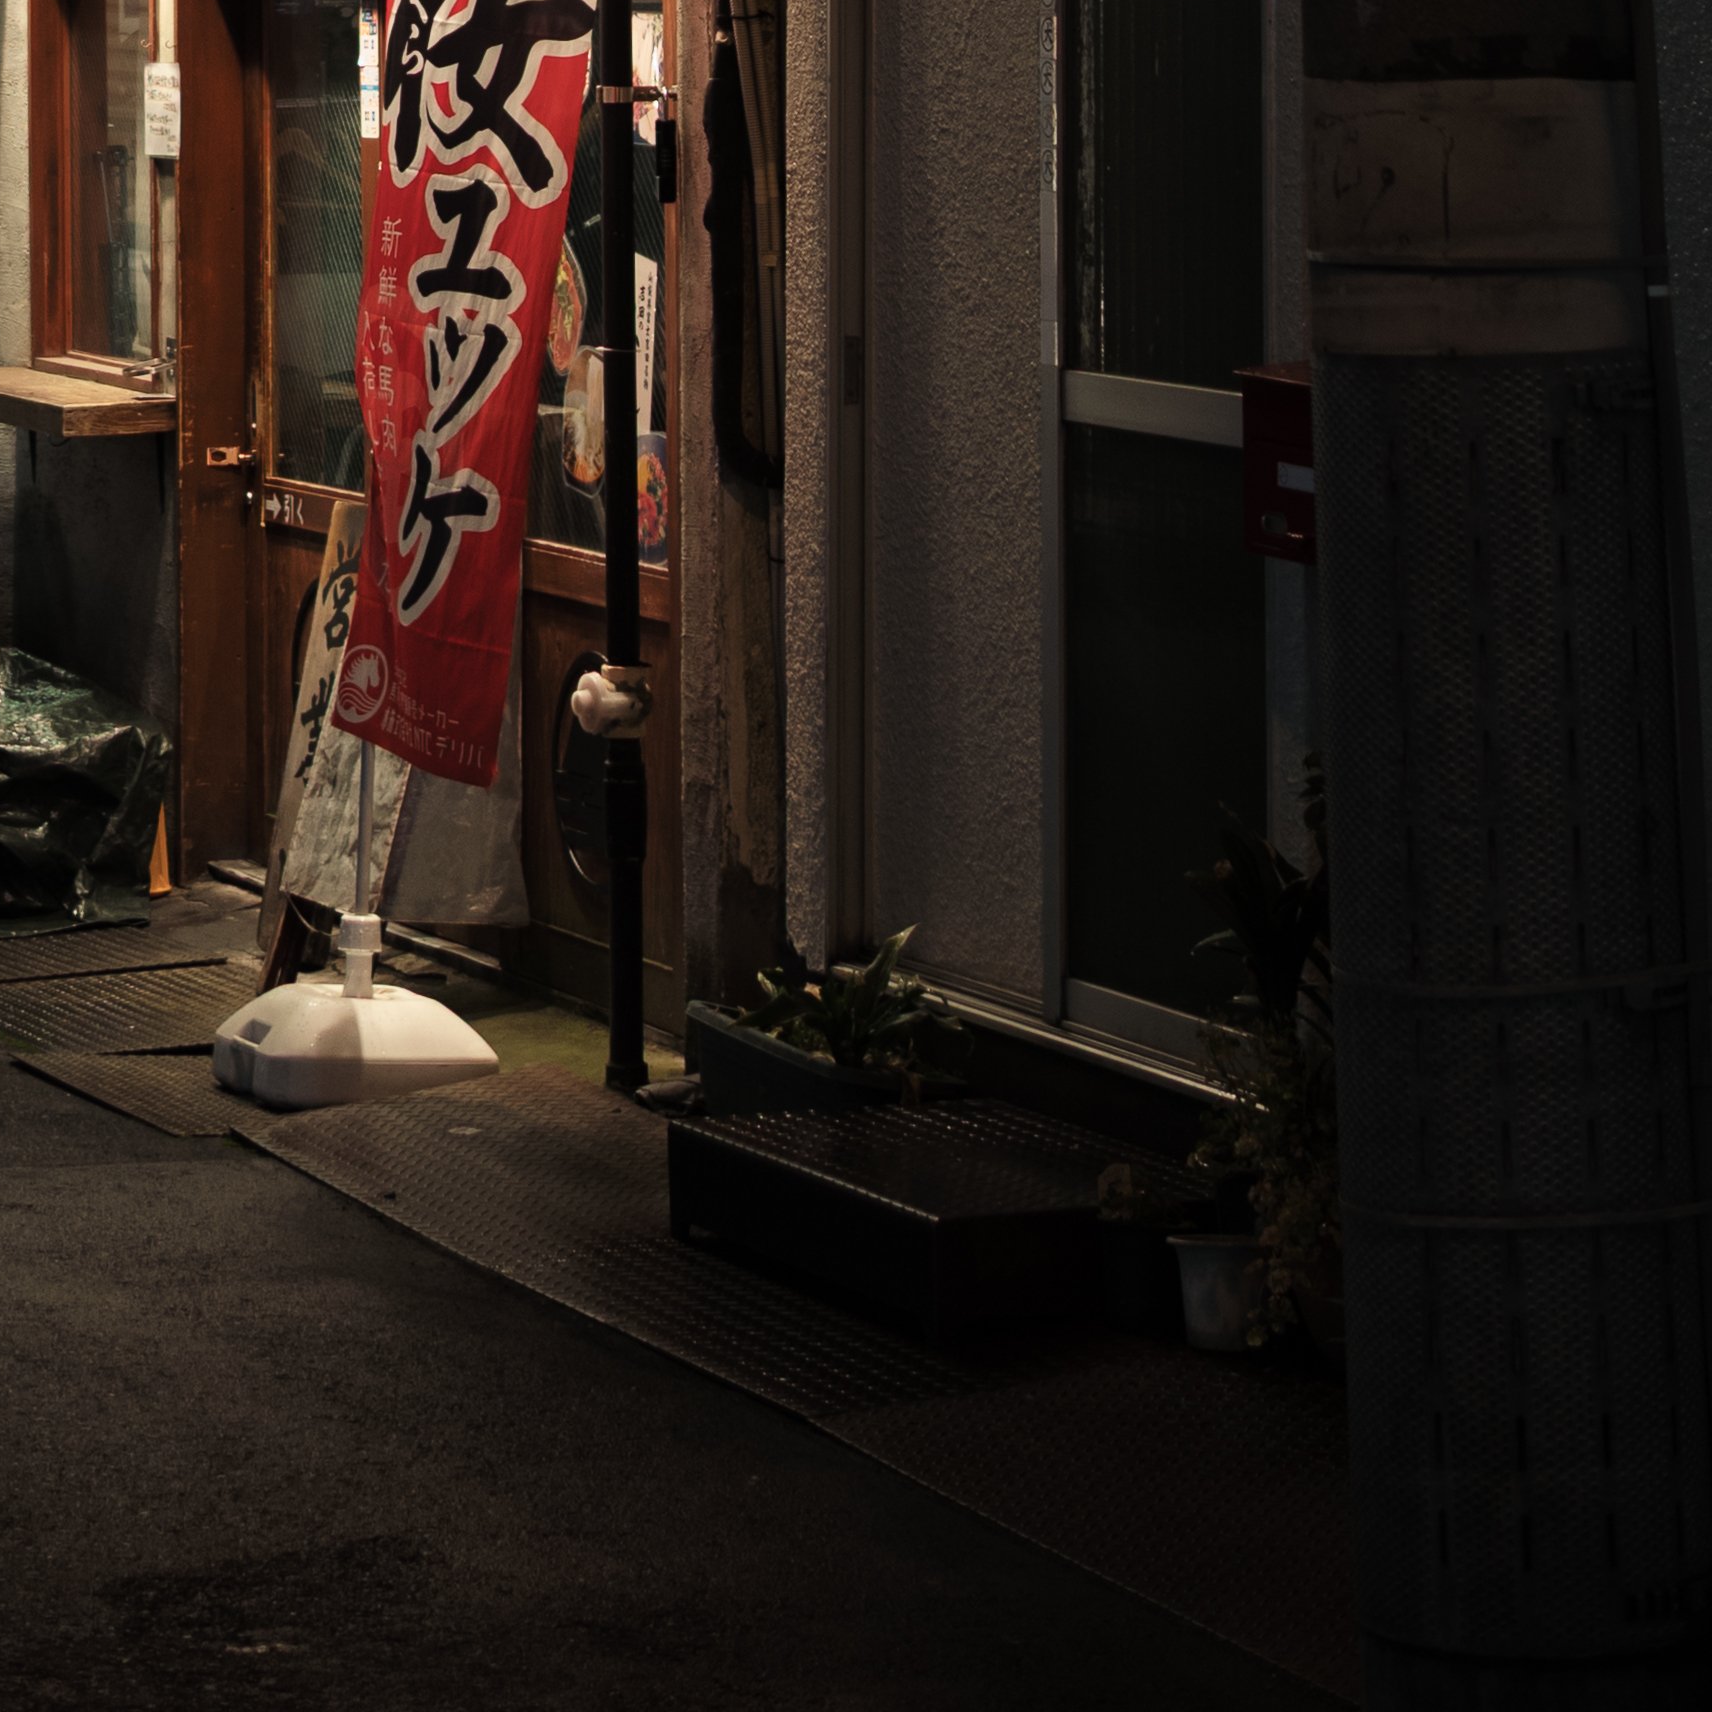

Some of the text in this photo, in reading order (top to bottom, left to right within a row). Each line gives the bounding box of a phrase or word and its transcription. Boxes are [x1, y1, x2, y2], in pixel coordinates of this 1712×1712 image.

[376, 215, 405, 459] 新鮮な馬肉
